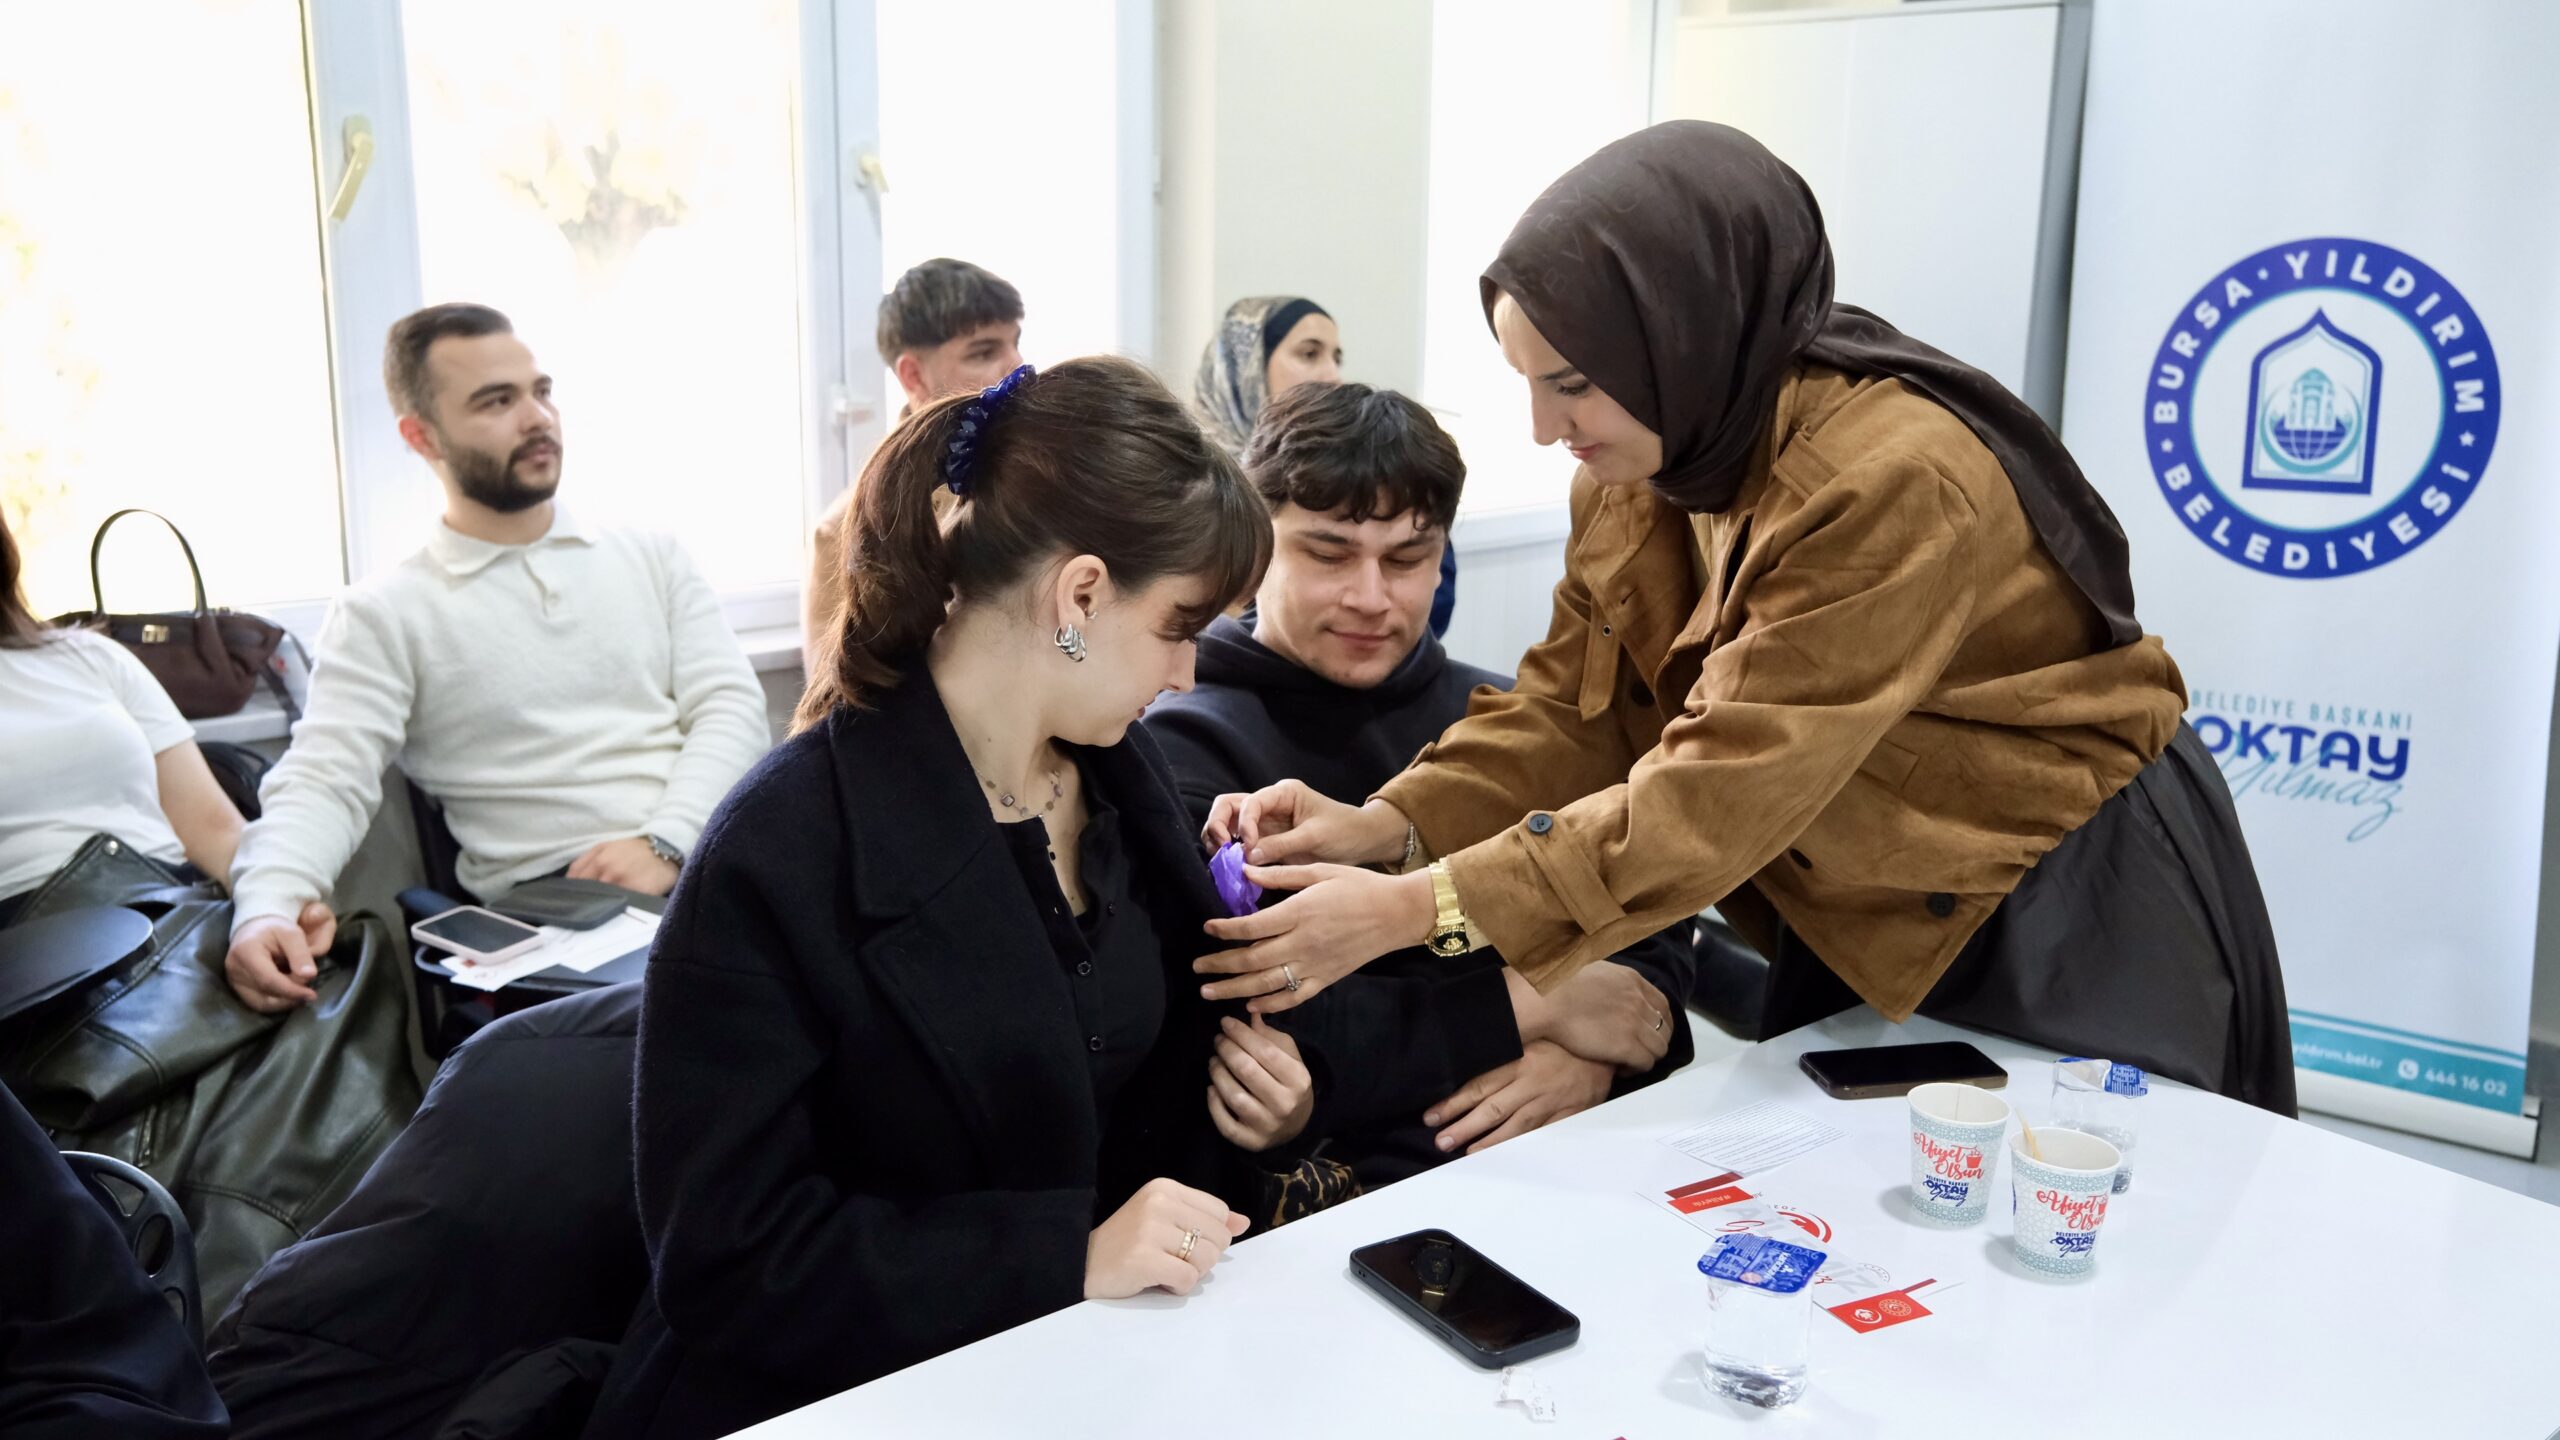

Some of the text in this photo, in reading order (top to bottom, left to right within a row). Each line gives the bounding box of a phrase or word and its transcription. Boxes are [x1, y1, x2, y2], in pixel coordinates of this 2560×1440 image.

[2153, 249, 2485, 425] BURSA YILDIRIM
[2163, 462, 2473, 569] BELEDİYESİ
[2192, 689, 2413, 731] BELEDİYE BAŞKANI
[2192, 714, 2411, 783] OKTAY
[2424, 1067, 2509, 1098] 444 16 02
[1913, 1131, 1977, 1163] Afiyet
[1926, 1179, 1969, 1195] OKTAY
[2036, 1189, 2105, 1216] Afiyet
[2055, 1234, 2096, 1246] OKTAY
